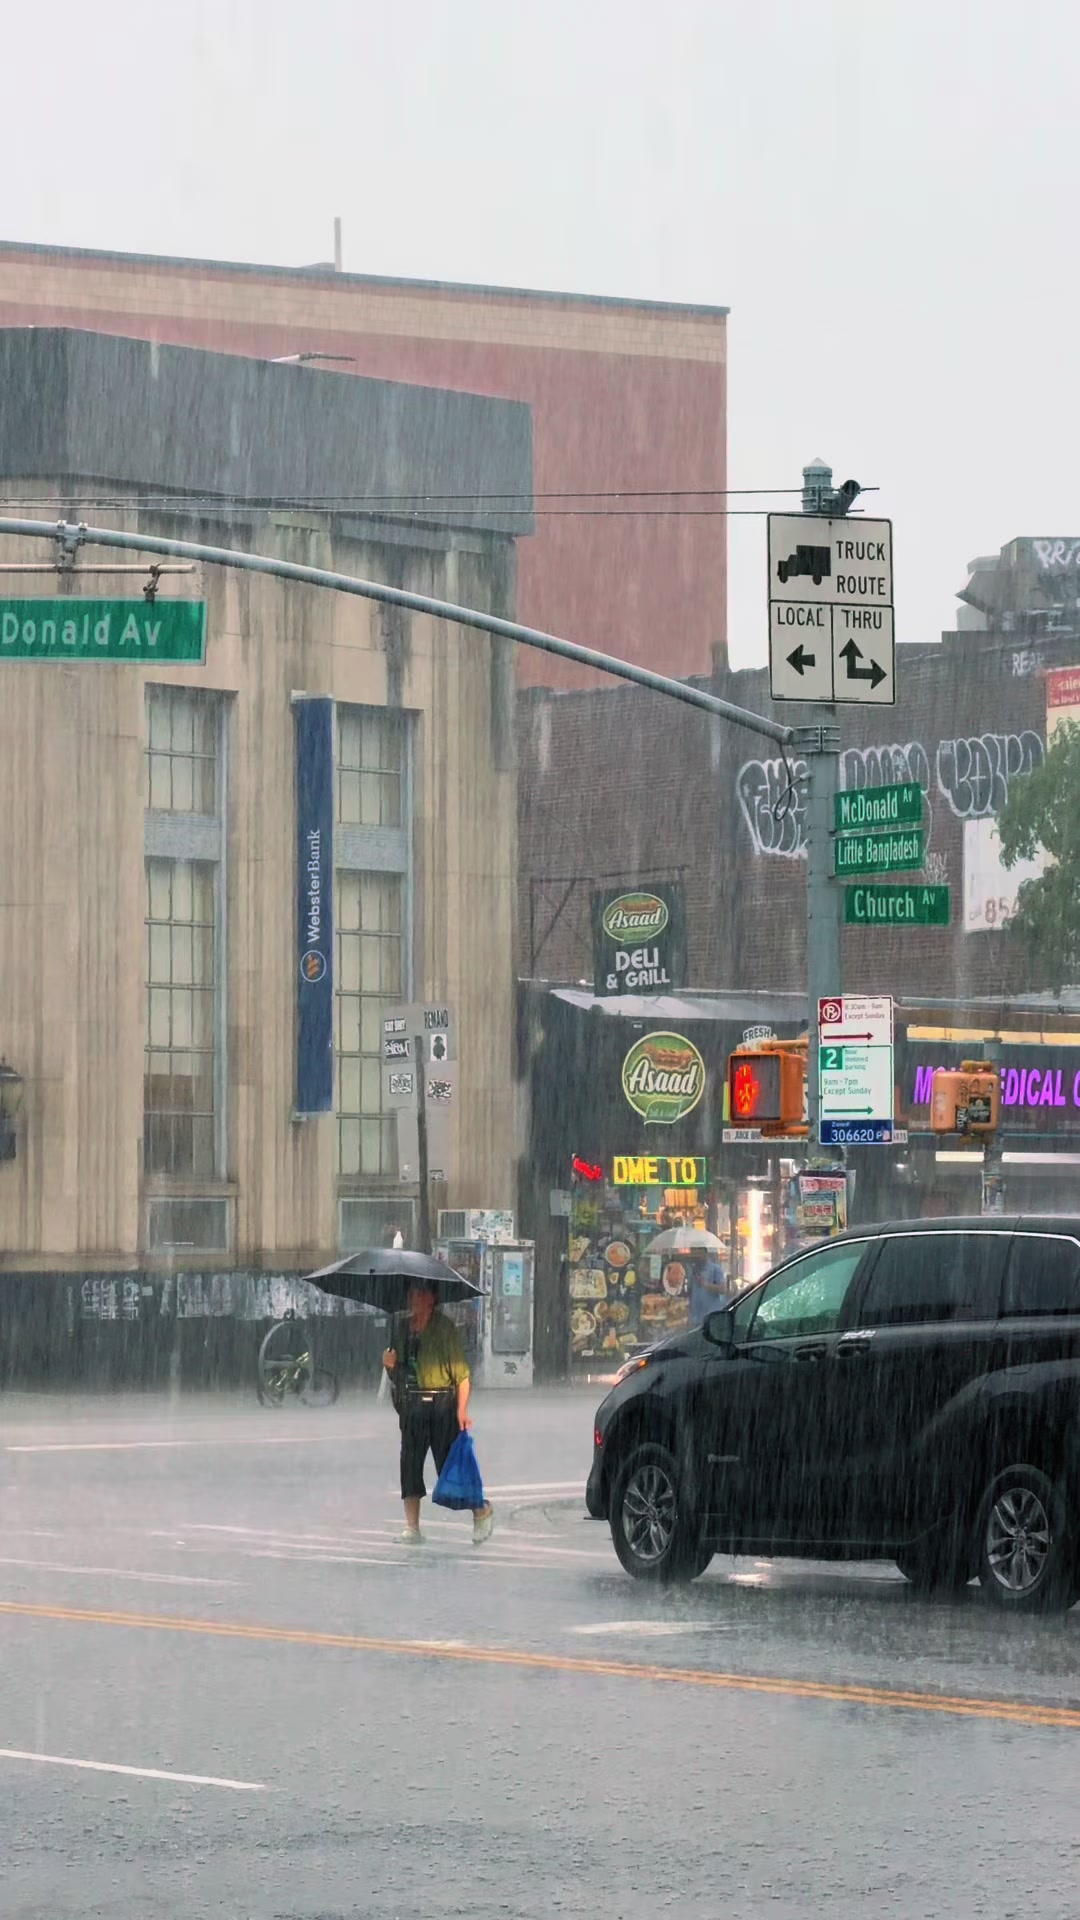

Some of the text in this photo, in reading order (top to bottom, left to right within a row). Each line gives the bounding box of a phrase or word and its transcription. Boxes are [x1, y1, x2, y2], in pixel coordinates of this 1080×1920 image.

[836, 541, 885, 561] TRUCK
[837, 575, 886, 595] ROUTE
[777, 607, 825, 627] LOCAL
[841, 609, 882, 630] THRU
[2, 612, 162, 646] Donald Av
[841, 787, 912, 824] McDonald Av
[838, 840, 863, 865] Little
[866, 834, 919, 869] Bangladesh
[854, 889, 935, 917] Church Av
[608, 907, 661, 929] Asaad
[615, 947, 659, 971] DELI
[606, 968, 670, 990] & GRILL
[865, 1012, 885, 1020] Sunday
[743, 1025, 772, 1042] FRESH
[825, 1049, 837, 1068] 2
[629, 1058, 698, 1094] Asaad
[844, 1078, 859, 1087] 7pm
[824, 1087, 871, 1095] Except Sunday
[1001, 1068, 1065, 1106] DICAL
[831, 1129, 874, 1142] 306620
[667, 1157, 697, 1184] TO
